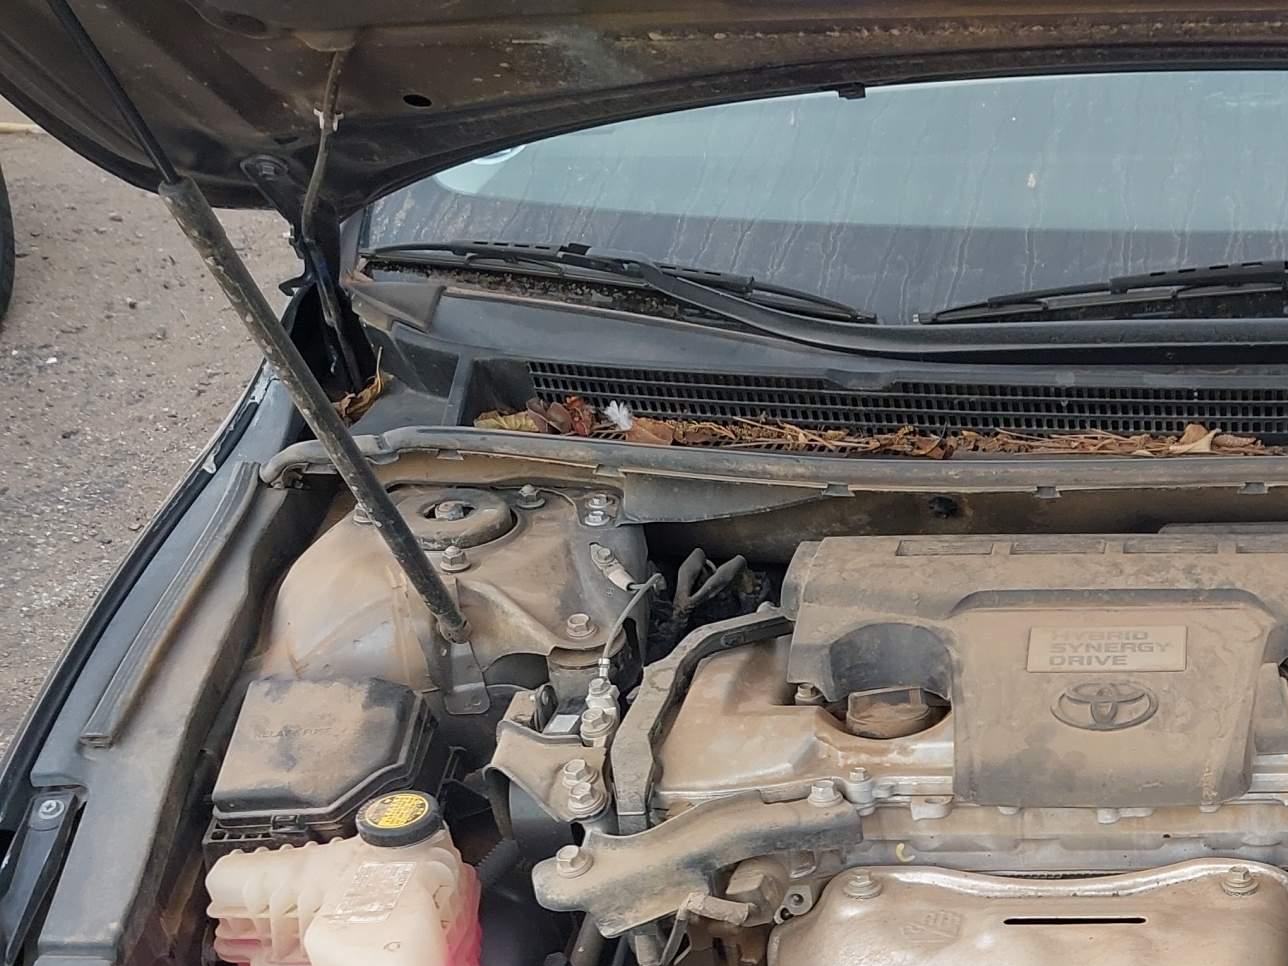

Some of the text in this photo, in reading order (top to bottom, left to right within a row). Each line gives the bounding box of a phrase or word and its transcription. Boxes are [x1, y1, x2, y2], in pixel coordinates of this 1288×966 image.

[1050, 631, 1149, 641] HYBRID
[1049, 642, 1171, 653] SYNERGY
[1049, 655, 1128, 666] DRIVE
